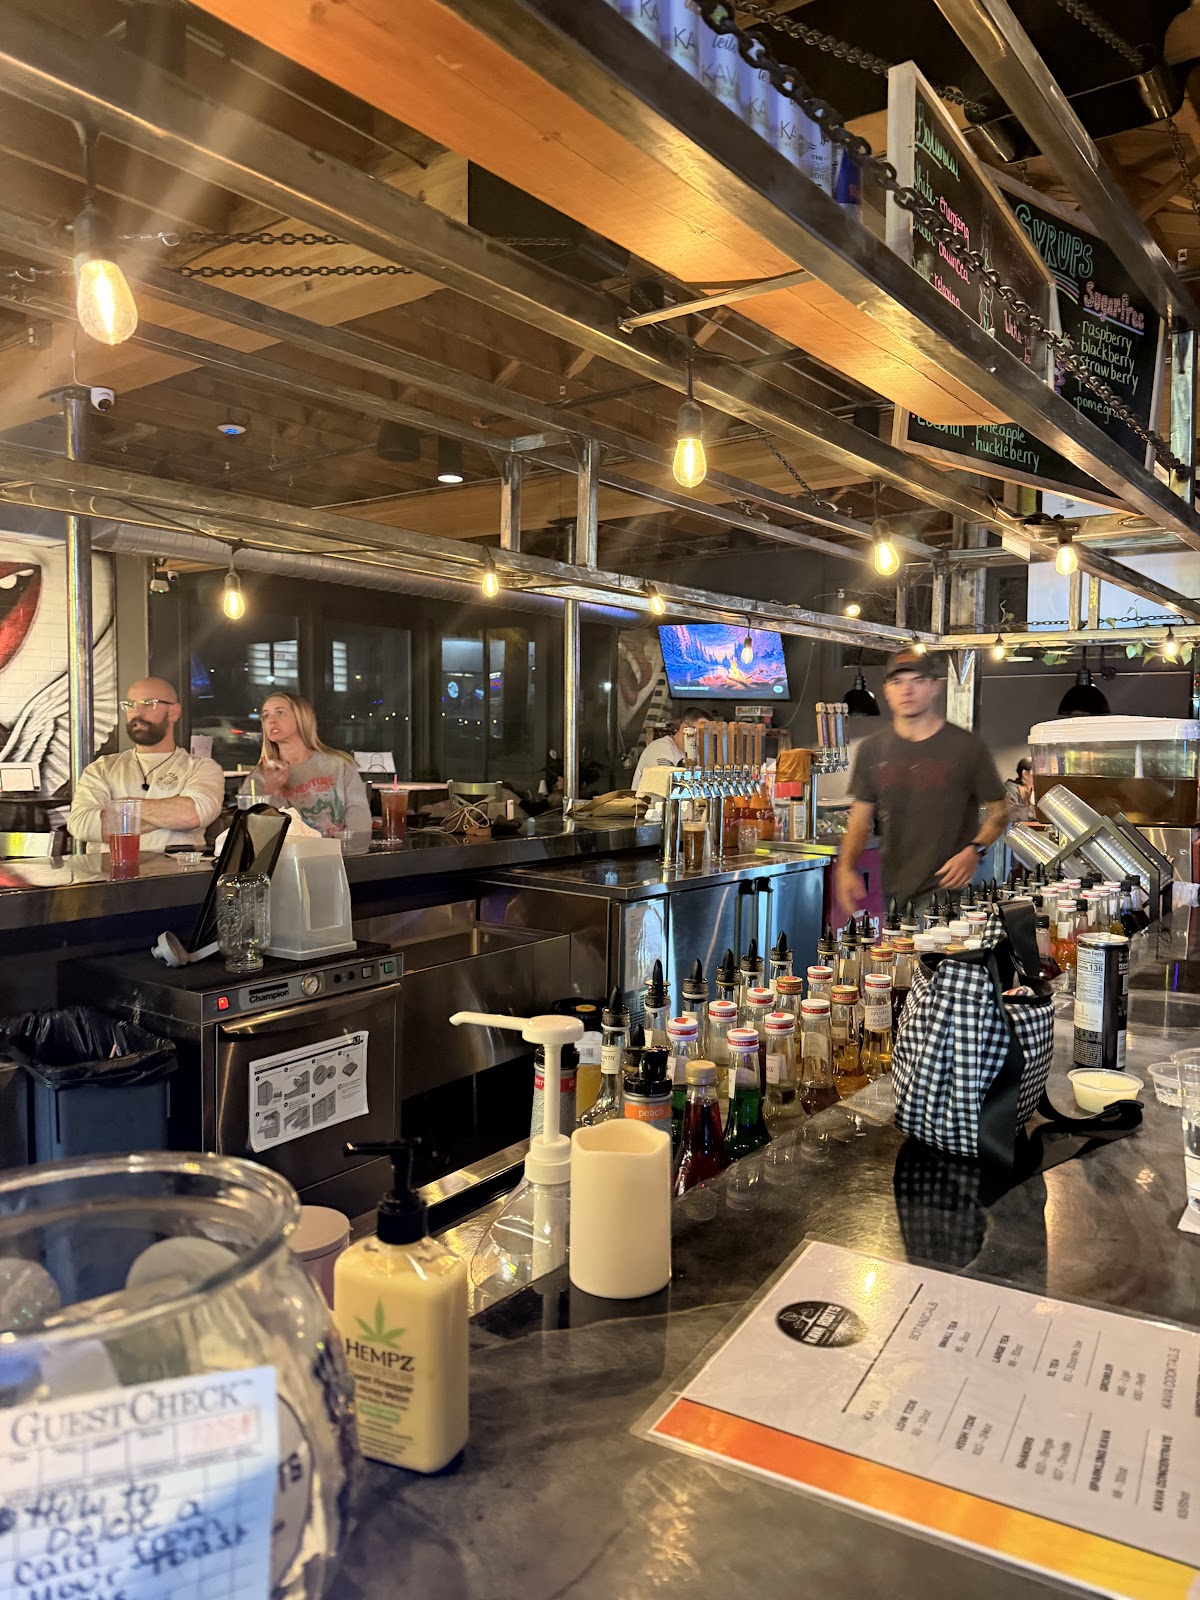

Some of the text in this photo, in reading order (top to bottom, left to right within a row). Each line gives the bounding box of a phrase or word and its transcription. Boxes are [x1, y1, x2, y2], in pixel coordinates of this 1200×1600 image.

[1015, 203, 1094, 278] SYRUPS
[1081, 336, 1135, 376] blackberry
[1082, 320, 1133, 356] raspberry
[1080, 355, 1139, 396] strawberry
[1076, 396, 1120, 425] pomegra
[975, 434, 1040, 473] huckleberry
[249, 988, 290, 1004] Champion
[638, 1107, 664, 1117] peach
[818, 1305, 842, 1329] ROOTS
[908, 1301, 939, 1341] BOTANICALS
[345, 1337, 415, 1372] HEMPZ
[1161, 1346, 1181, 1410] KAVA COCKTAILS
[862, 1400, 882, 1421] KAVA
[895, 1399, 918, 1432] LOW TIDE
[954, 1414, 977, 1451] HIGH TIDE
[1016, 1436, 1035, 1470] SHAKERS
[1088, 1450, 1107, 1493] SPARKLING
[1152, 1433, 1173, 1513] KAVA CONCENTRATE
